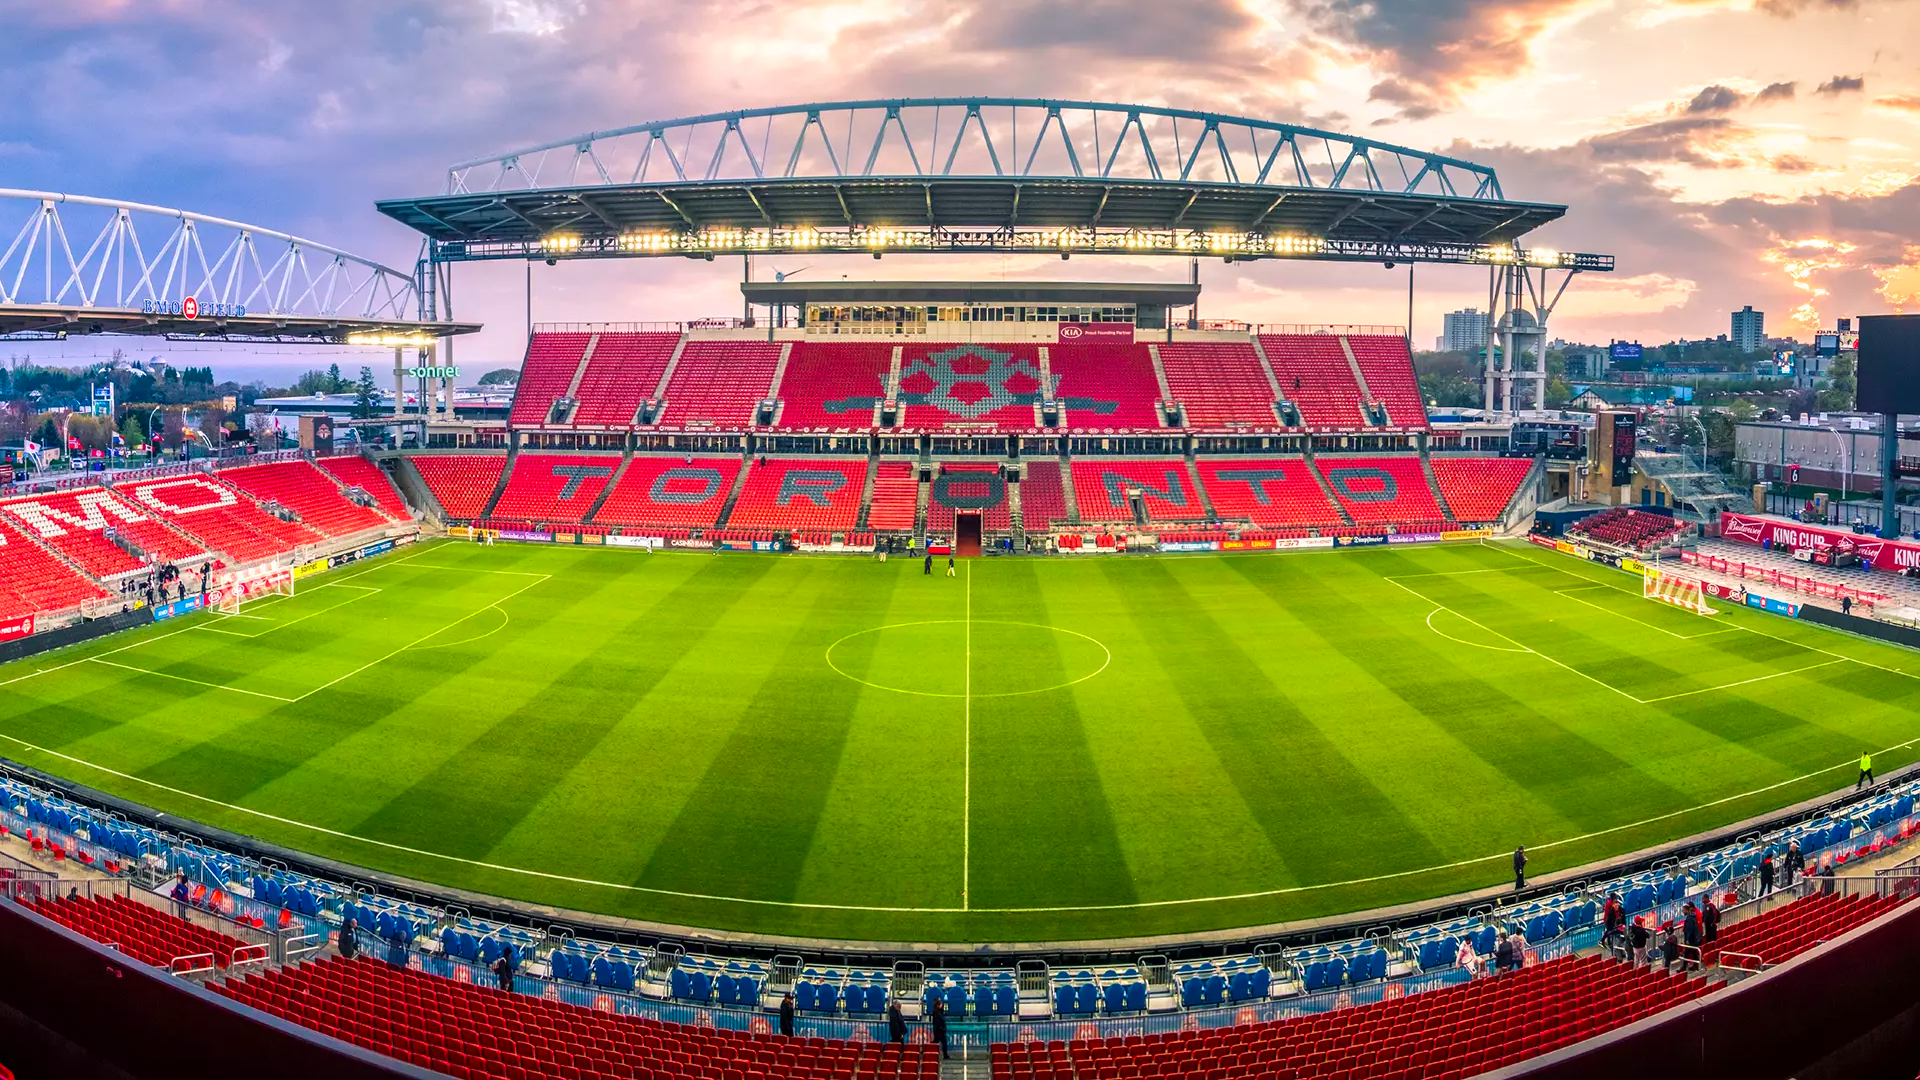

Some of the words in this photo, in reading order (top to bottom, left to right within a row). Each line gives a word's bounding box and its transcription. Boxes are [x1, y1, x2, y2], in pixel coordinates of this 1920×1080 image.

[144, 299, 180, 315] BMO
[201, 301, 247, 317] FIELD
[408, 364, 461, 378] sonnet
[1617, 428, 1633, 437] ALL
[1617, 438, 1633, 446] FOR
[1616, 447, 1633, 455] ONE
[1792, 469, 1798, 482] 6
[552, 465, 1397, 508] TORONTO
[0, 478, 238, 546] MO
[1727, 518, 1762, 537] Budweiser
[1773, 527, 1797, 547] KING
[300, 563, 318, 574] sonnet
